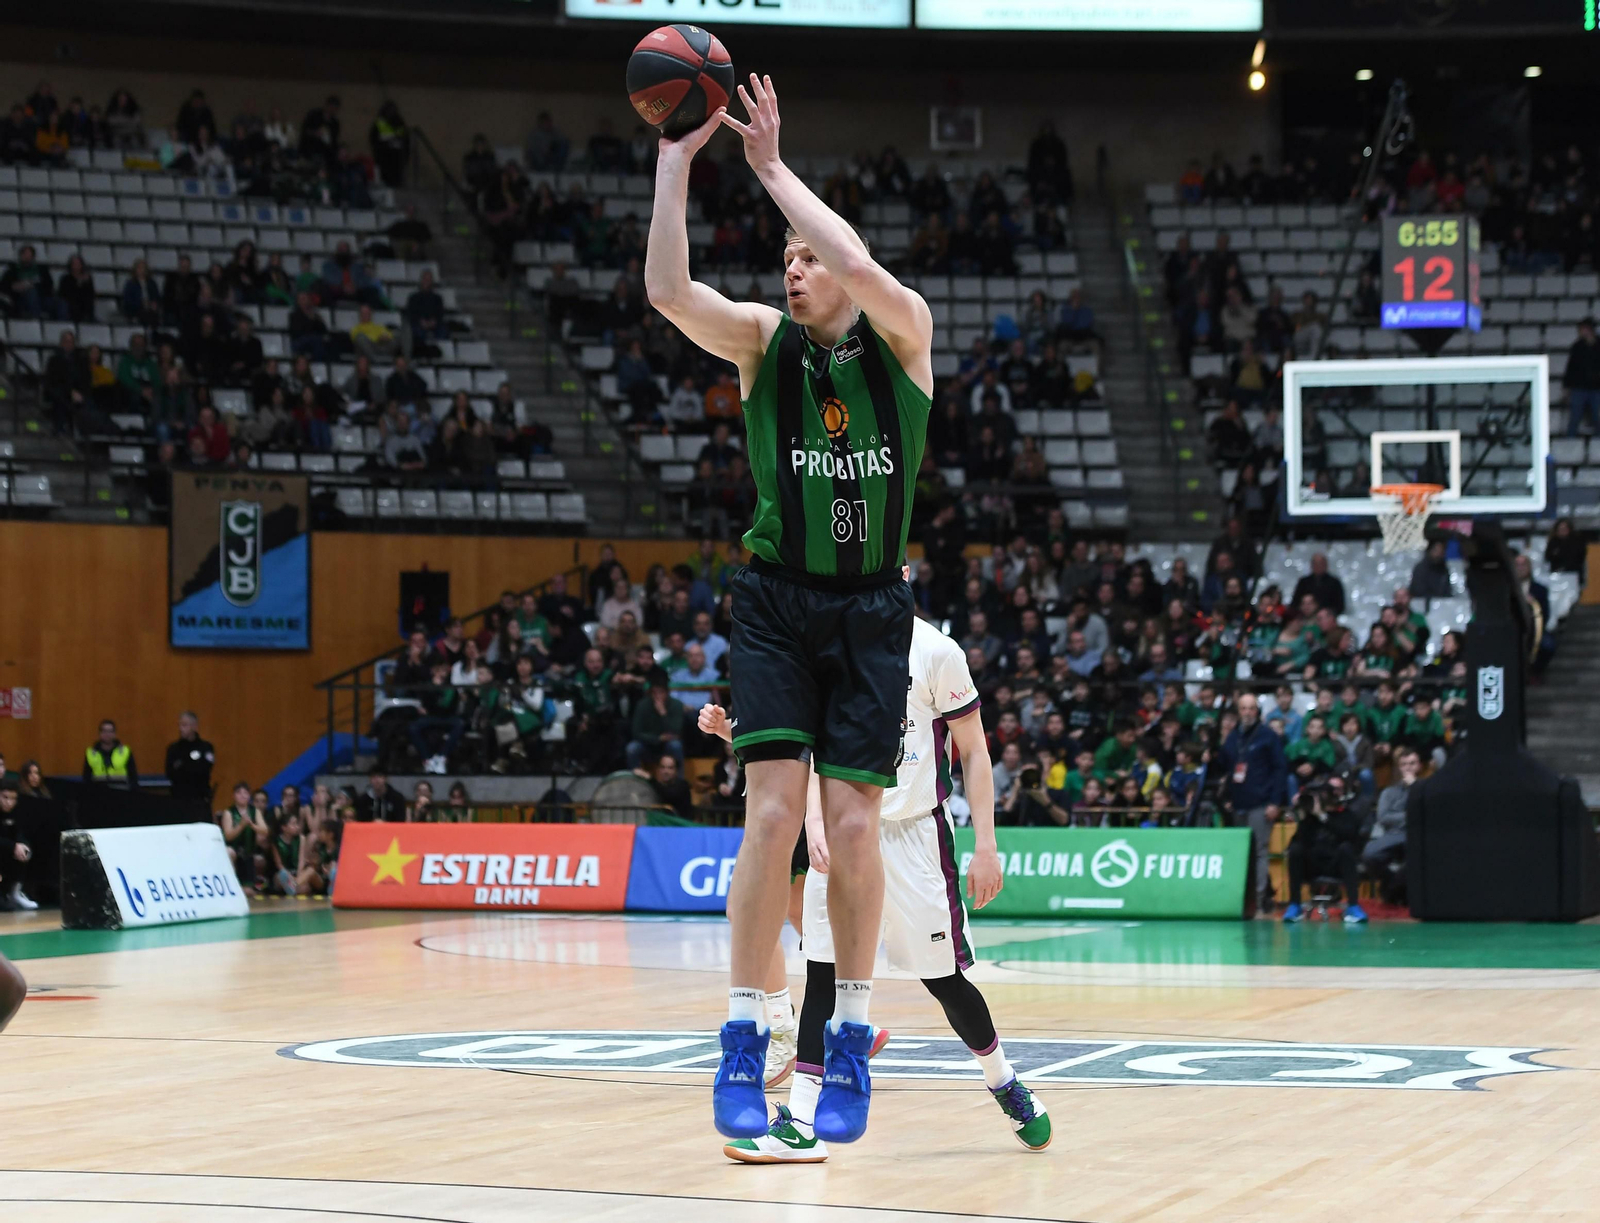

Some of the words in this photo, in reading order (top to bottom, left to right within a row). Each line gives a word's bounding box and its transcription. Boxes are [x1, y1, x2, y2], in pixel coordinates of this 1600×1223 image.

[1398, 221, 1458, 247] 6:55
[1393, 256, 1454, 302] 12
[791, 433, 889, 453] FUNACIÓN
[791, 446, 894, 480] PROBITAS
[831, 498, 868, 543] 81
[227, 506, 255, 595] CJB
[177, 614, 300, 630] MARESME
[420, 854, 600, 888] ESTRELLA
[959, 852, 1084, 877] BDALONA
[1143, 854, 1223, 879] FUTUR
[147, 874, 236, 902] BALLESOL
[475, 888, 540, 906] DAMM
